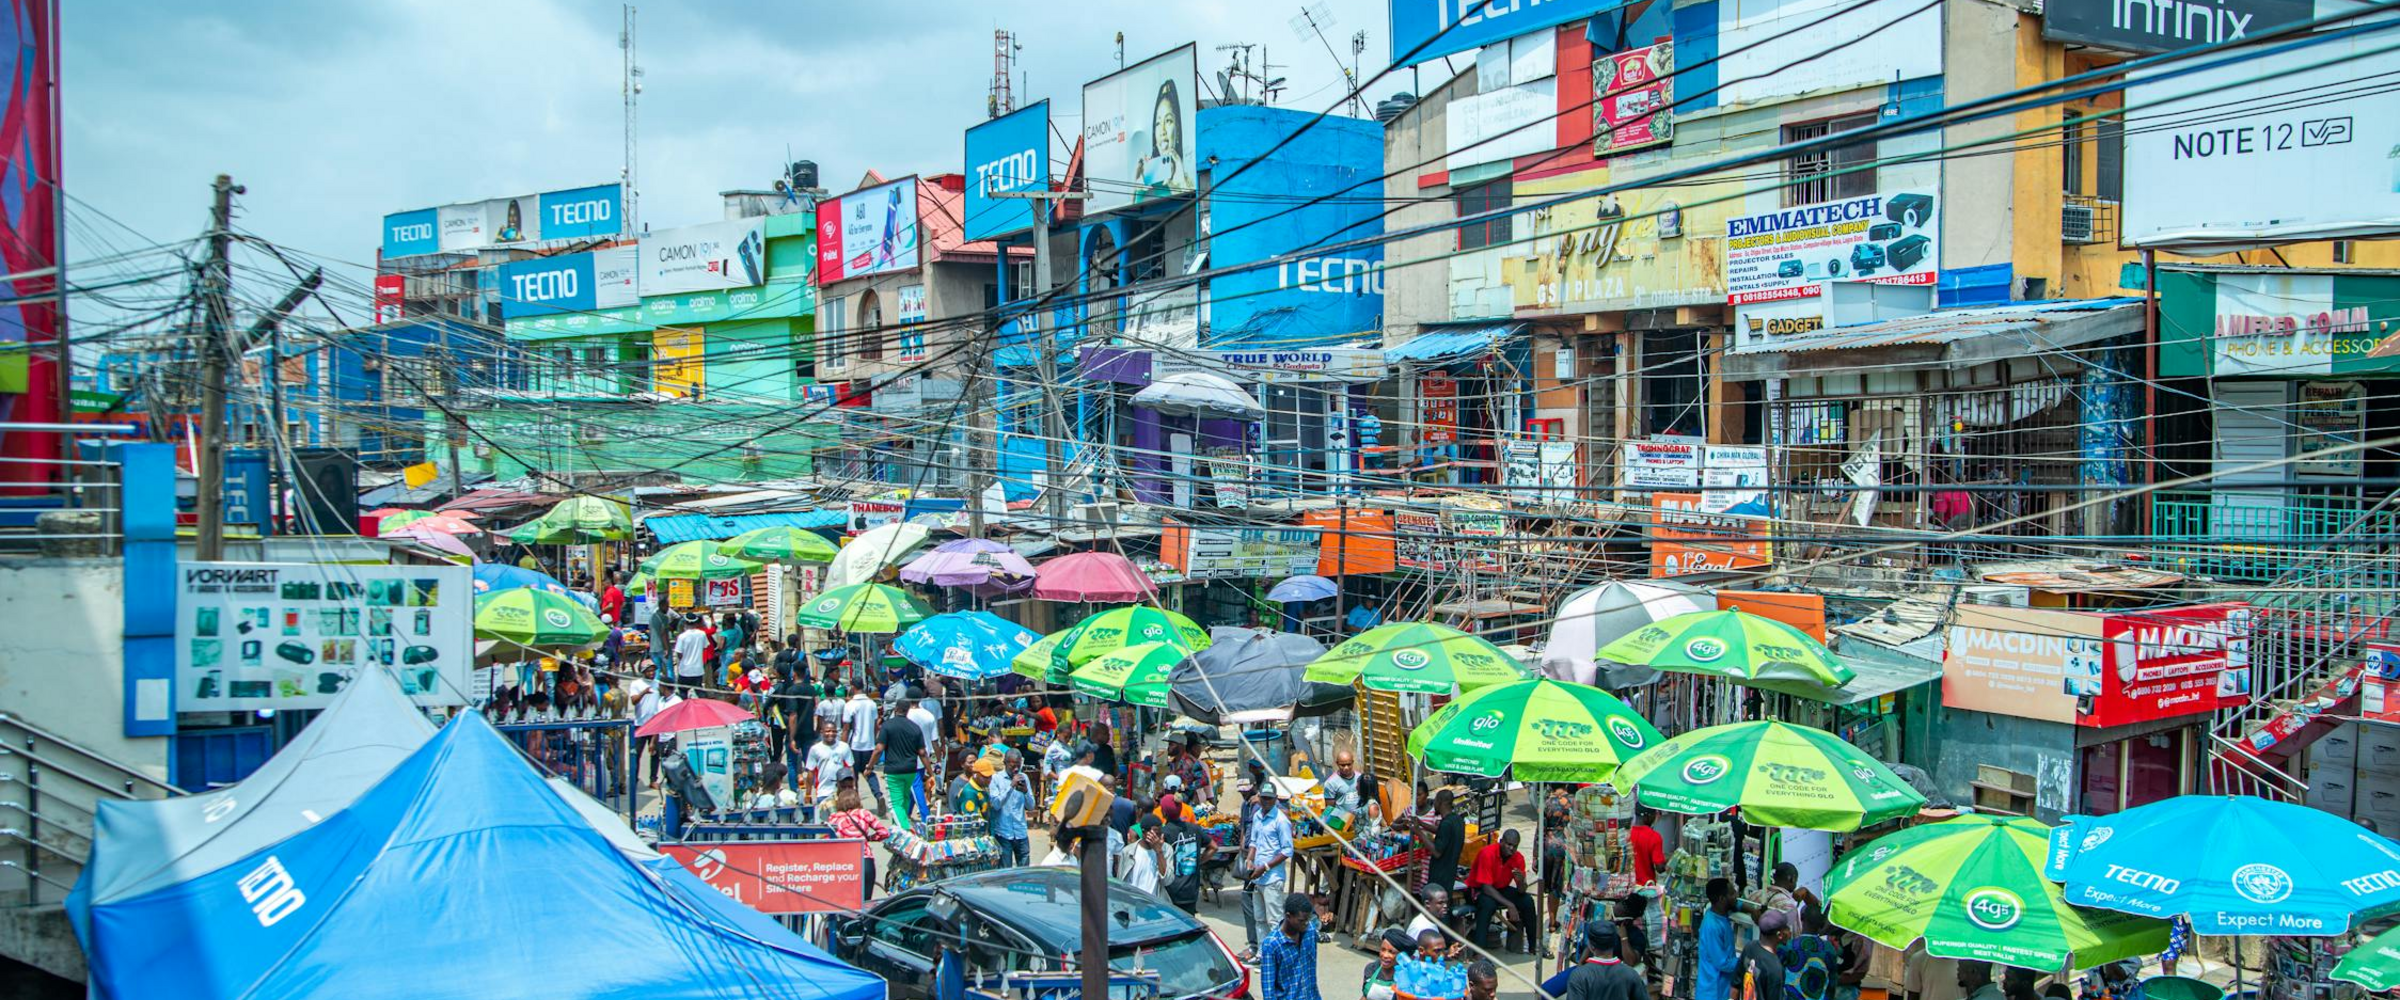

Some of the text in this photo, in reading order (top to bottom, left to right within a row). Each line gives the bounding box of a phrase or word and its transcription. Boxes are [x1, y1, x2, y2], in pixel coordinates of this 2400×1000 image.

[1086, 120, 1111, 140] CAMON
[2174, 127, 2254, 160] NOTE
[2262, 123, 2293, 151] 12
[976, 148, 1036, 199] TECNO
[551, 198, 611, 226] TECNO
[1728, 197, 1882, 238] EMMATECH
[392, 223, 433, 243] TECNO
[1729, 233, 1774, 250] PROJECTORS
[1782, 226, 1830, 243] AUDIOVISUAL
[1831, 220, 1869, 236] COMPANY
[660, 244, 697, 262] CAMON
[1730, 256, 1769, 266] PROJECTOR
[1730, 266, 1758, 274] REPAIRS
[1730, 273, 1777, 283] INSTALLATION
[512, 268, 578, 302] TECNO
[1575, 277, 1625, 302] PLAZA
[1766, 317, 1823, 335] GADGET
[2227, 338, 2382, 357] PHONE & ACCESSOR
[1221, 352, 1332, 364] TRUE WORLD
[186, 569, 279, 584] VORWART
[1143, 626, 1165, 637] glo
[1968, 628, 2063, 656] MACDIN
[1472, 715, 1499, 731] glo
[1453, 737, 1493, 749] Unlimited
[1765, 790, 1816, 798] EVERYTHING
[766, 861, 854, 874] Register, Replace
[2054, 850, 2070, 870] More
[766, 883, 813, 893] SIM Here
[767, 873, 860, 885] and Recharge your
[2104, 863, 2180, 895] TECNO
[236, 855, 307, 927] TECNO
[1863, 890, 1904, 910] EVERYTHING
[1874, 886, 1887, 894] ONE
[1888, 890, 1906, 900] CODE
[2084, 886, 2162, 912] Expect More
[2217, 911, 2323, 930] Expect More
[1932, 940, 2058, 961] SUPERIOR QUALITY FASTEST SPEED
[1993, 952, 2015, 962] VALUE
